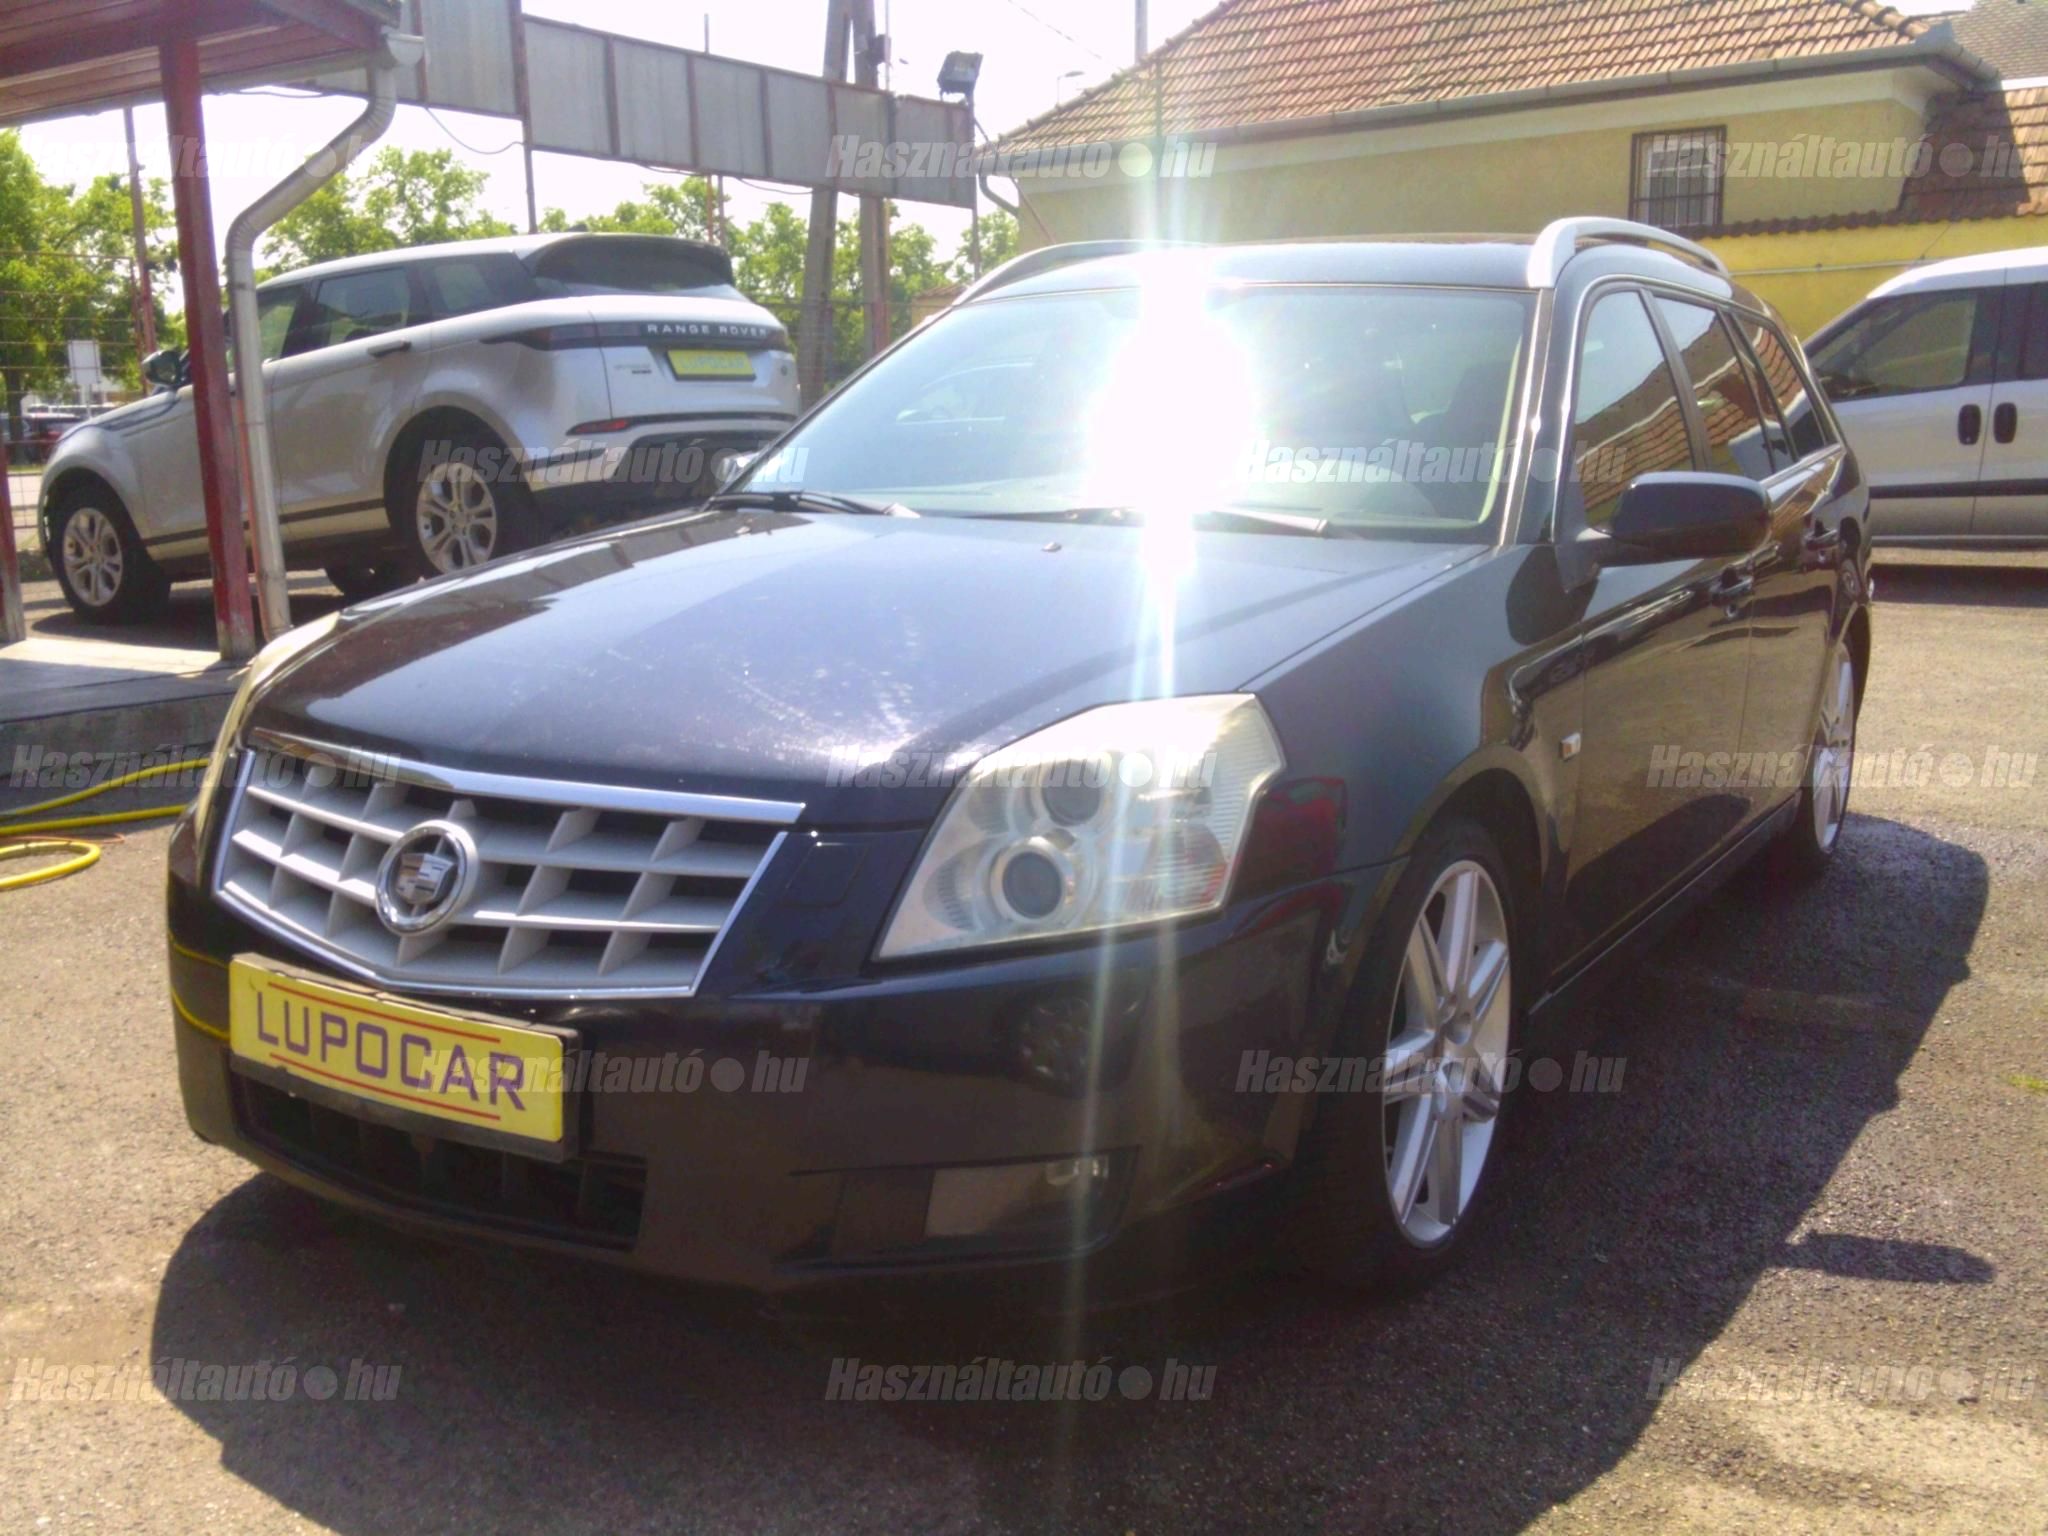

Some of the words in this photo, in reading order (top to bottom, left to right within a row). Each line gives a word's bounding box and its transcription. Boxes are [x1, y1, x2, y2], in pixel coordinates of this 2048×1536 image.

[647, 324, 710, 335] RANGE
[719, 325, 767, 337] ROVER
[256, 991, 525, 1111] LUPOCAR
